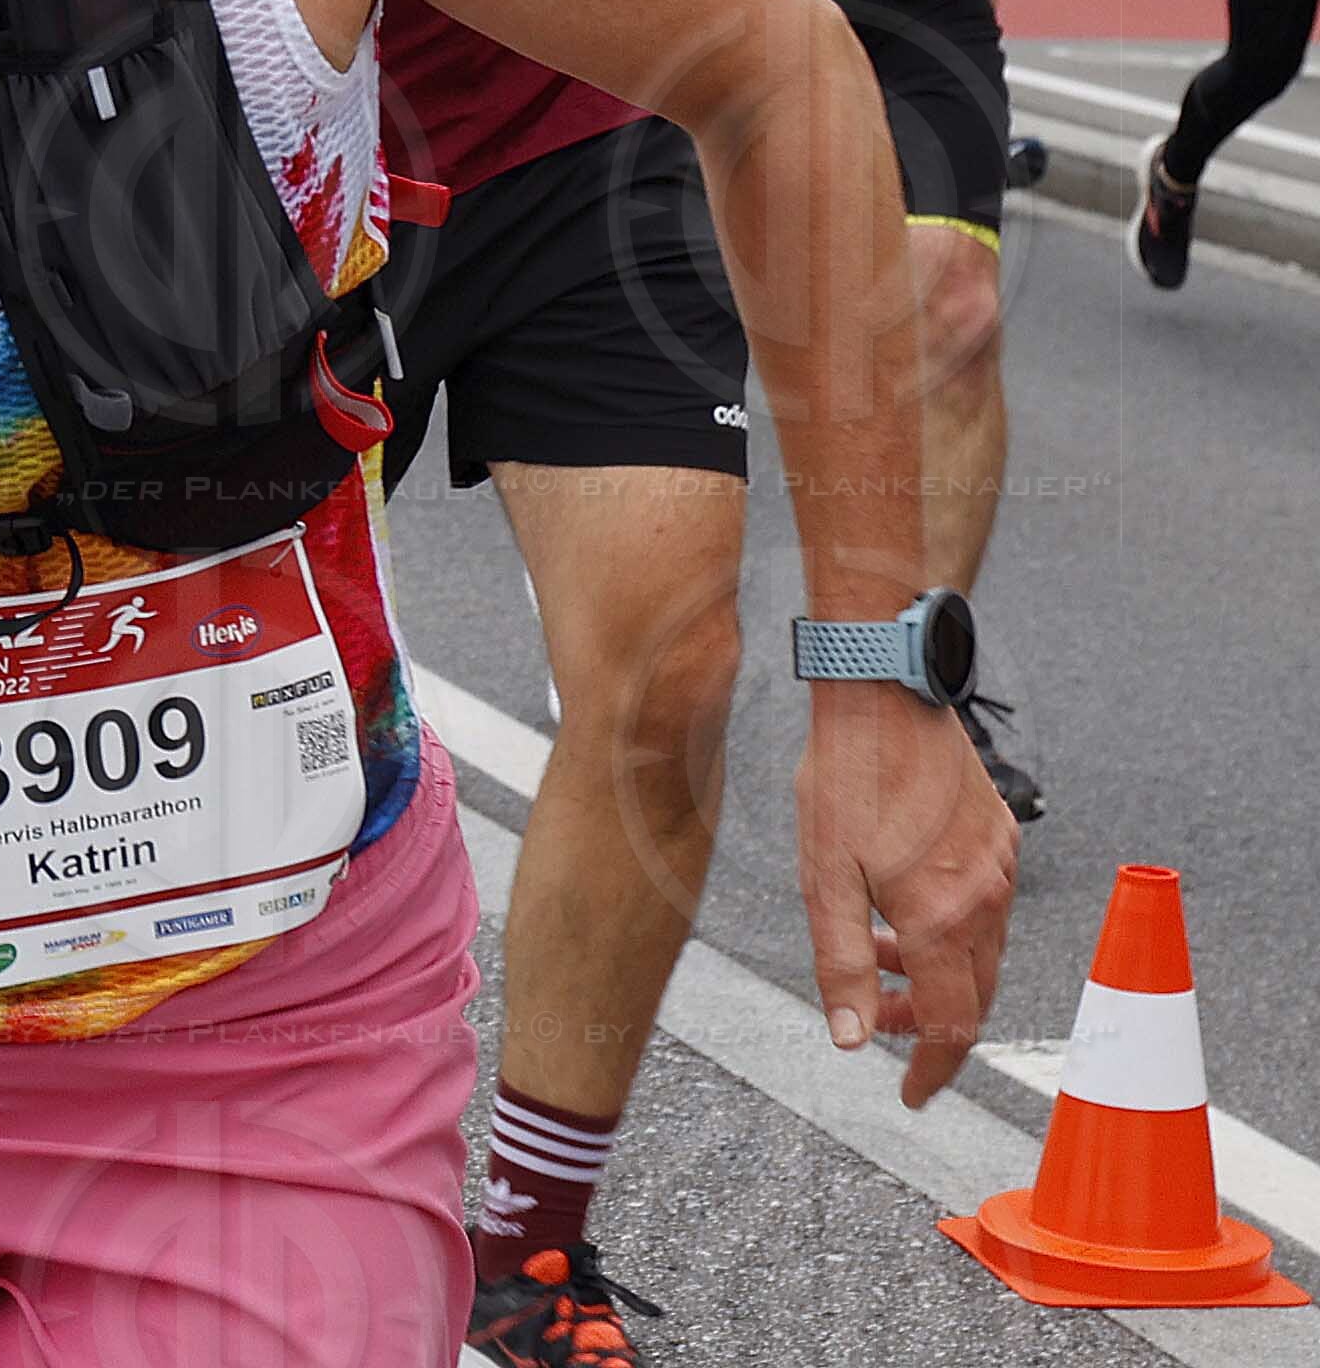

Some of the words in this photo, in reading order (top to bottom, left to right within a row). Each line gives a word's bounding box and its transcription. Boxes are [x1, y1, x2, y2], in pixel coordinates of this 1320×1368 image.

[198, 615, 258, 647] Hervis
[50, 795, 203, 837] Halbmarathon
[27, 837, 157, 885] Katrin
